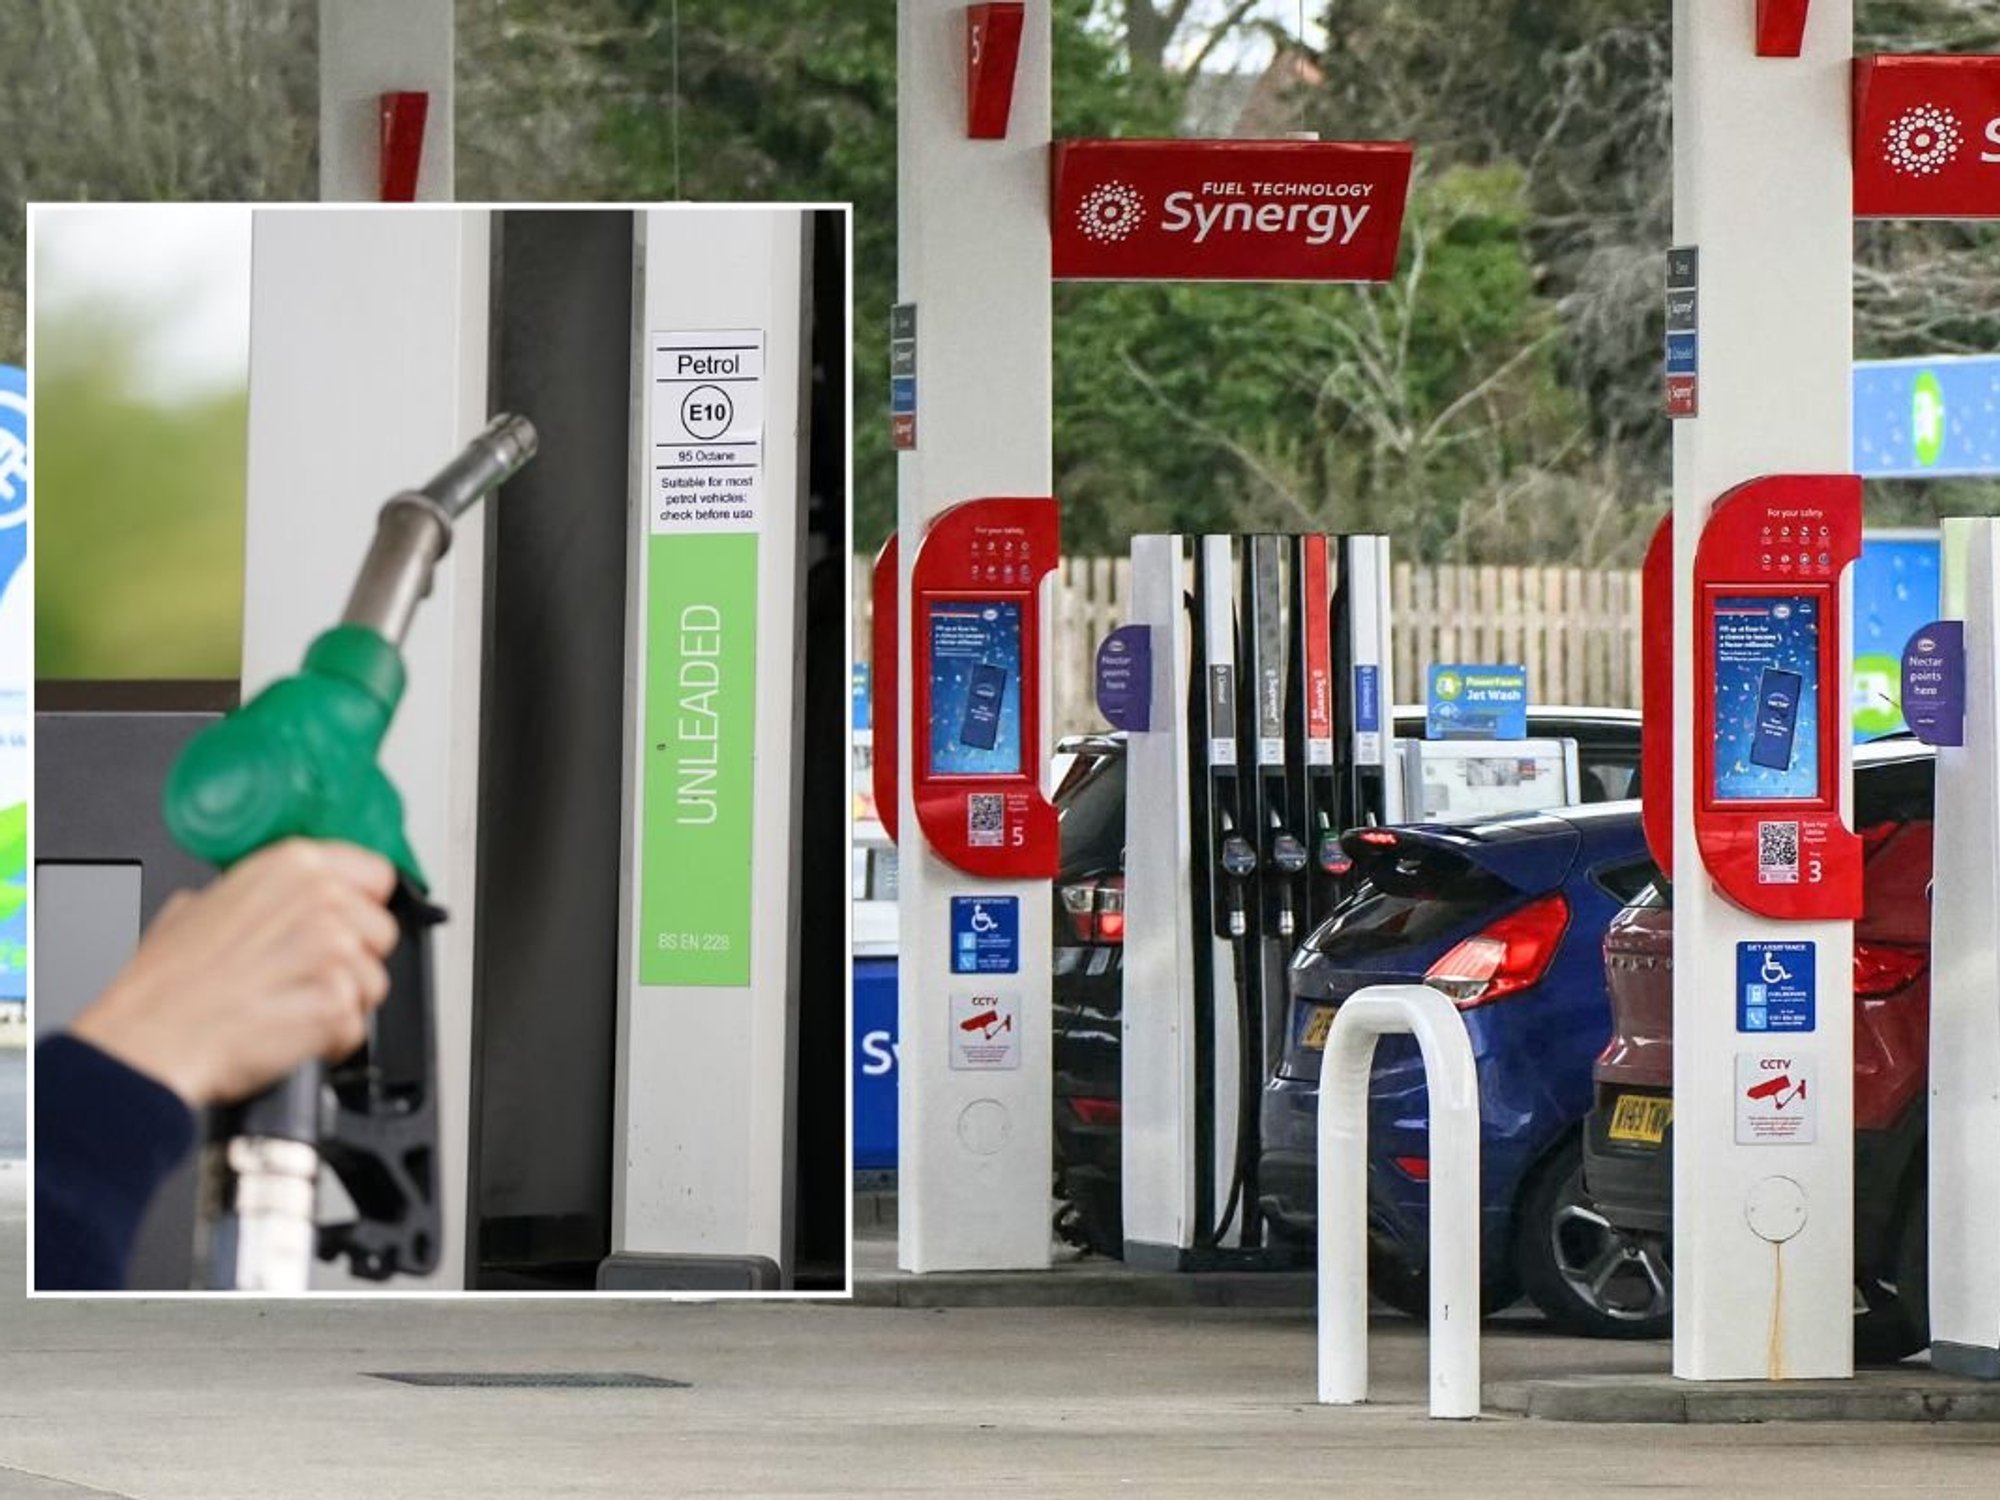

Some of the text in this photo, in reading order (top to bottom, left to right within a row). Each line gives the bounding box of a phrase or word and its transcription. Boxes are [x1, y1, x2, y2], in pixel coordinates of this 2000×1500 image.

[972, 25, 980, 64] 5
[1202, 182, 1374, 197] FUEL TECHNOLOGY
[1161, 191, 1371, 245] Synergy
[677, 354, 740, 375] Petrol
[689, 403, 727, 422] E10
[678, 450, 735, 463] 95 Octane
[661, 476, 753, 489] Suitable for most
[665, 493, 697, 506] petrol
[660, 509, 753, 521] check before use
[1781, 509, 1799, 518] your
[1909, 656, 1942, 667] Nectar
[1910, 671, 1941, 683] points
[1466, 689, 1522, 701] Jet Wash
[1914, 686, 1937, 696] here
[676, 604, 721, 825] UNLEADED
[1012, 826, 1024, 847] 5
[1808, 860, 1822, 883] 3
[658, 934, 730, 950] BS EN 228
[971, 996, 998, 1006] CCTV
[862, 1029, 898, 1076] S
[1760, 1059, 1792, 1070] CCTV
